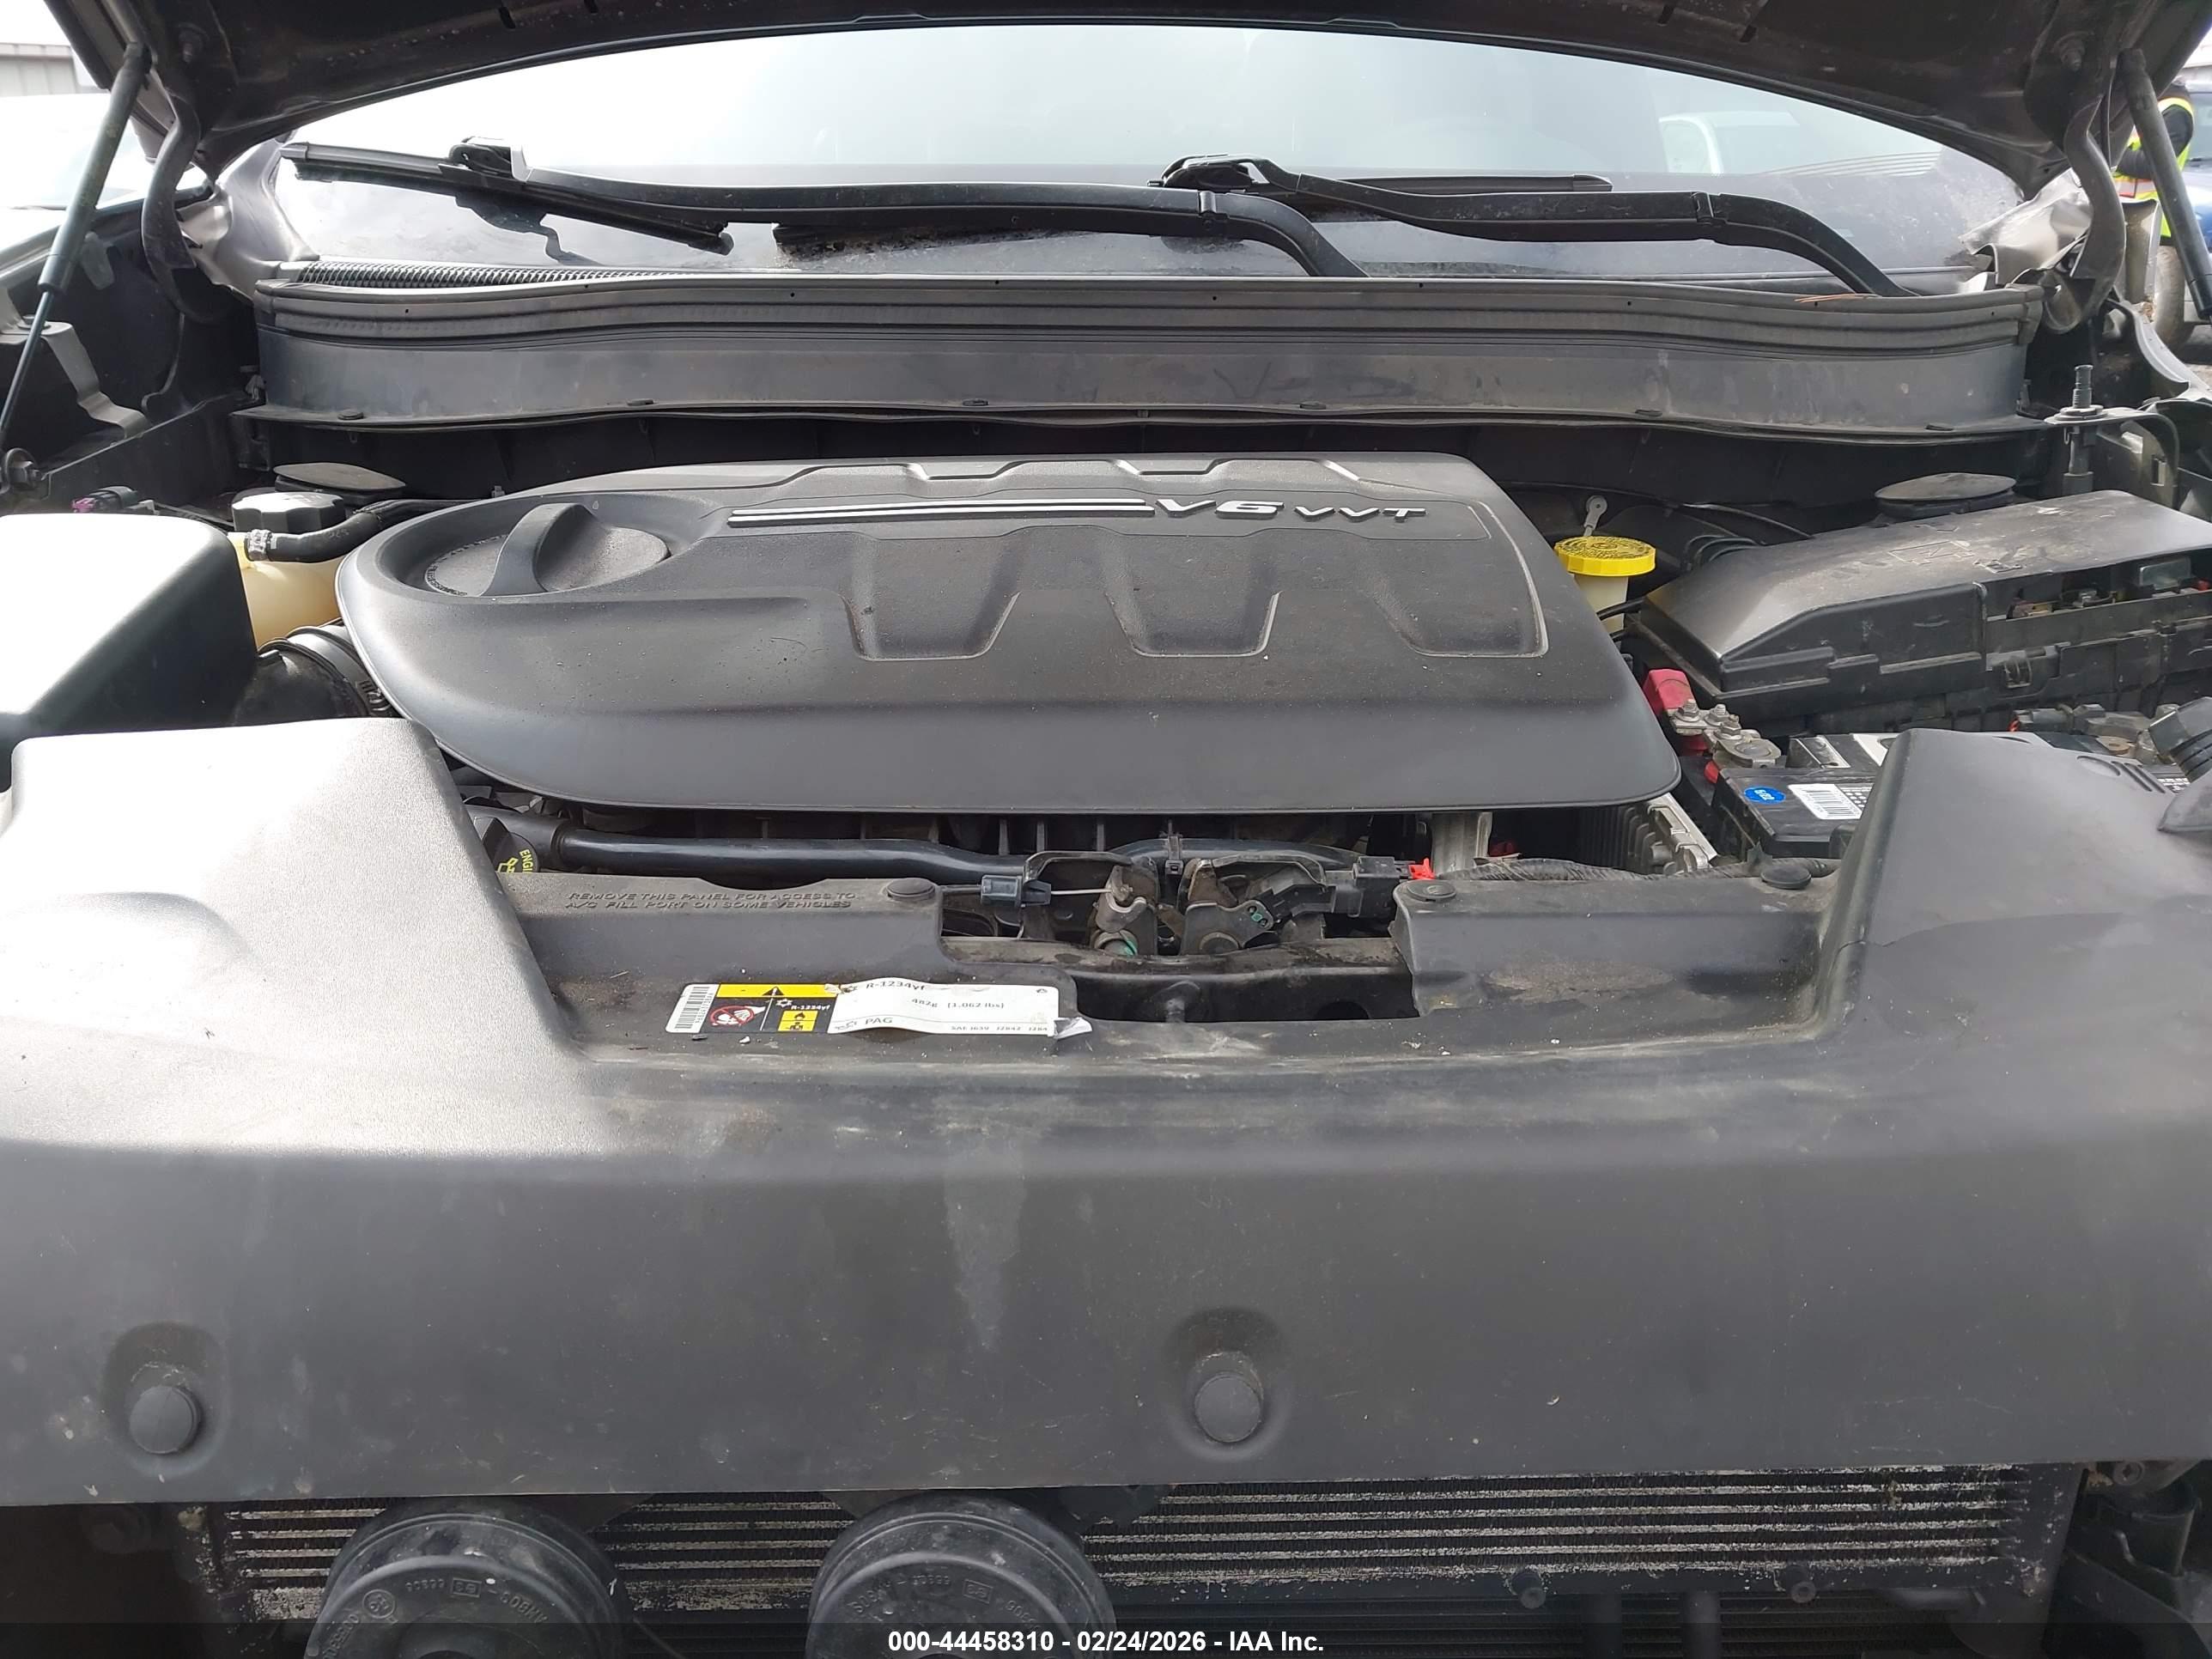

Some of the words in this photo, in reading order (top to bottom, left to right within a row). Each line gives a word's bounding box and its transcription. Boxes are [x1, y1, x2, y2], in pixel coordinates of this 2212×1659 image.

[1157, 498, 1285, 520] V6
[1294, 505, 1427, 523] VVT
[519, 848, 534, 873] ENGI
[567, 892, 637, 901] REMOVE
[641, 892, 677, 901] THIS
[682, 892, 731, 901] PANEL
[734, 892, 768, 901] FOR
[769, 892, 833, 901] ACCESS
[836, 892, 856, 901] TO
[564, 901, 599, 909] A/C
[605, 901, 639, 909] FILL
[644, 901, 688, 909] PORT
[692, 901, 719, 909] ON
[720, 901, 769, 909] SOME
[774, 901, 852, 909] VEHICLES
[866, 981, 926, 990] R-1234yf
[865, 1017, 893, 1025] PAG
